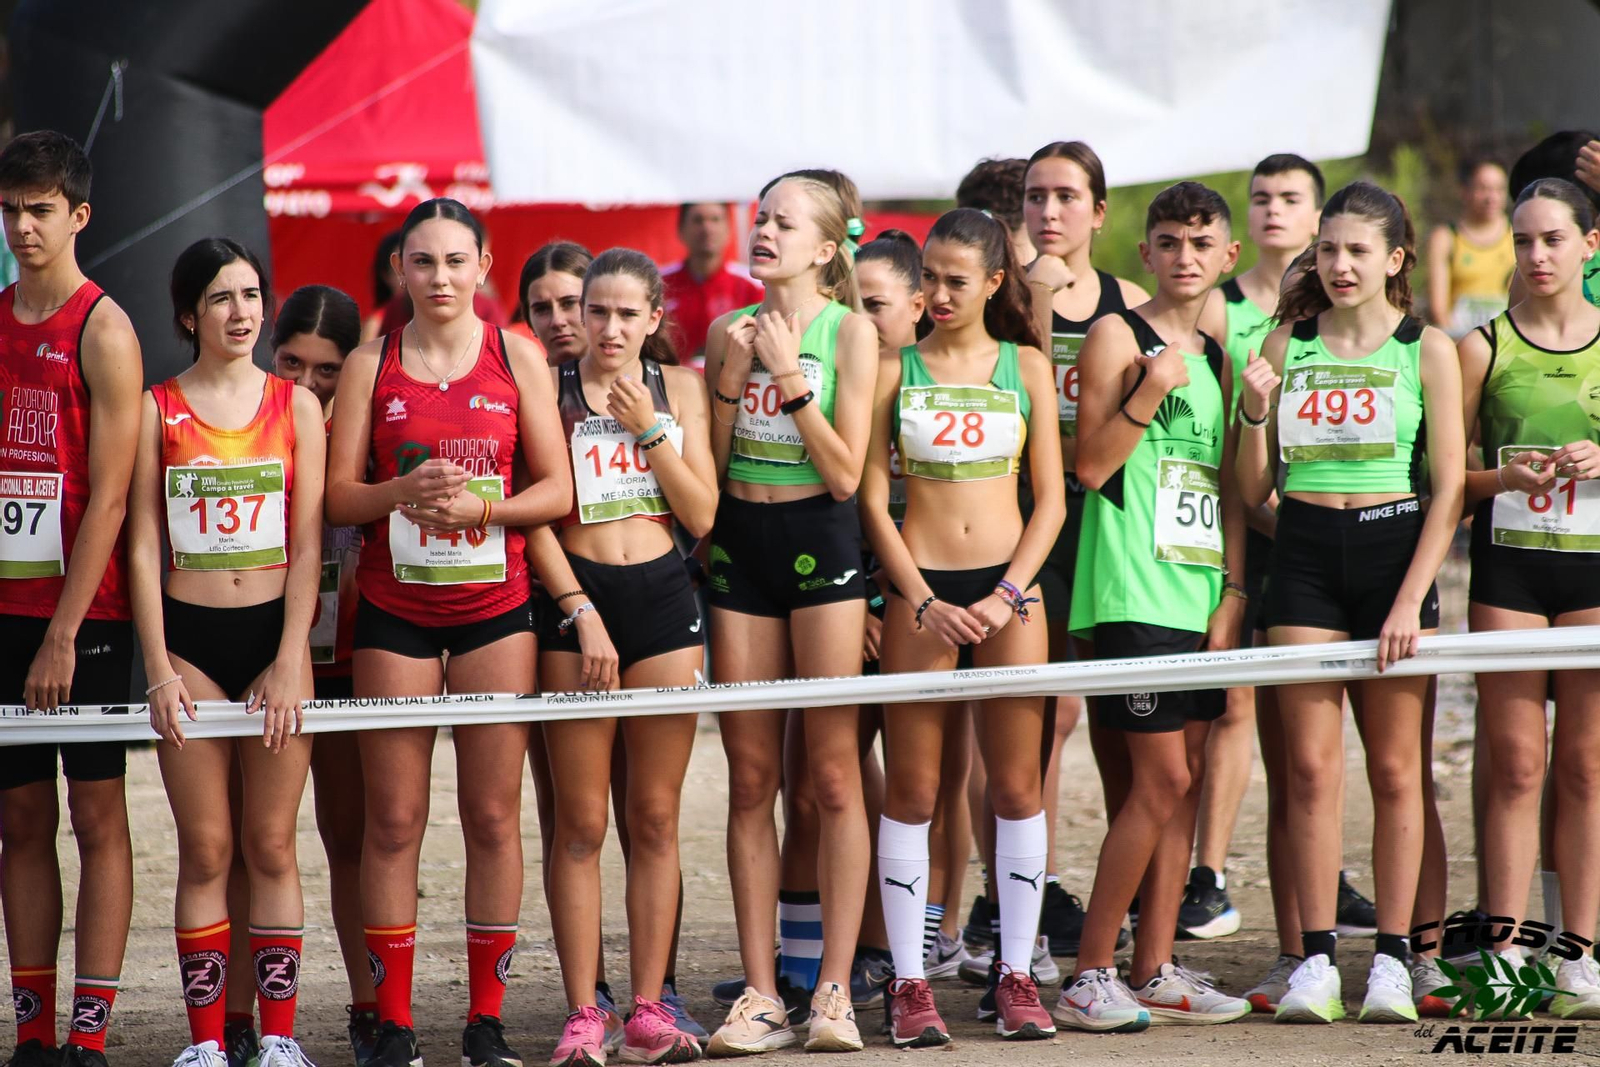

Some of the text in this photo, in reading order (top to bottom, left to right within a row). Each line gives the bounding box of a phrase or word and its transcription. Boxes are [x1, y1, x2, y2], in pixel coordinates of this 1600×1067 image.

[1062, 366, 1080, 402] 6
[743, 382, 782, 418] 50
[1297, 388, 1377, 426] 493
[7, 407, 57, 449] ALBOR
[584, 420, 602, 436] CROSS
[750, 418, 771, 428] ELENA
[932, 411, 985, 449] 28
[439, 436, 499, 458] FUNDACIÓN
[9, 449, 58, 465] PROFESIONAL
[23, 478, 35, 496] DEL
[35, 479, 56, 497] ACEITE
[233, 483, 255, 491] través
[601, 487, 662, 502] MESAS GAM
[0, 500, 47, 536] 97
[189, 494, 266, 535] 137
[1359, 500, 1419, 522] NIKE PRO
[425, 558, 454, 566] Provincial
[993, 668, 1039, 677] INTERIOR
[338, 693, 428, 710] PROVINCIAL
[588, 692, 634, 702] INTERIOR
